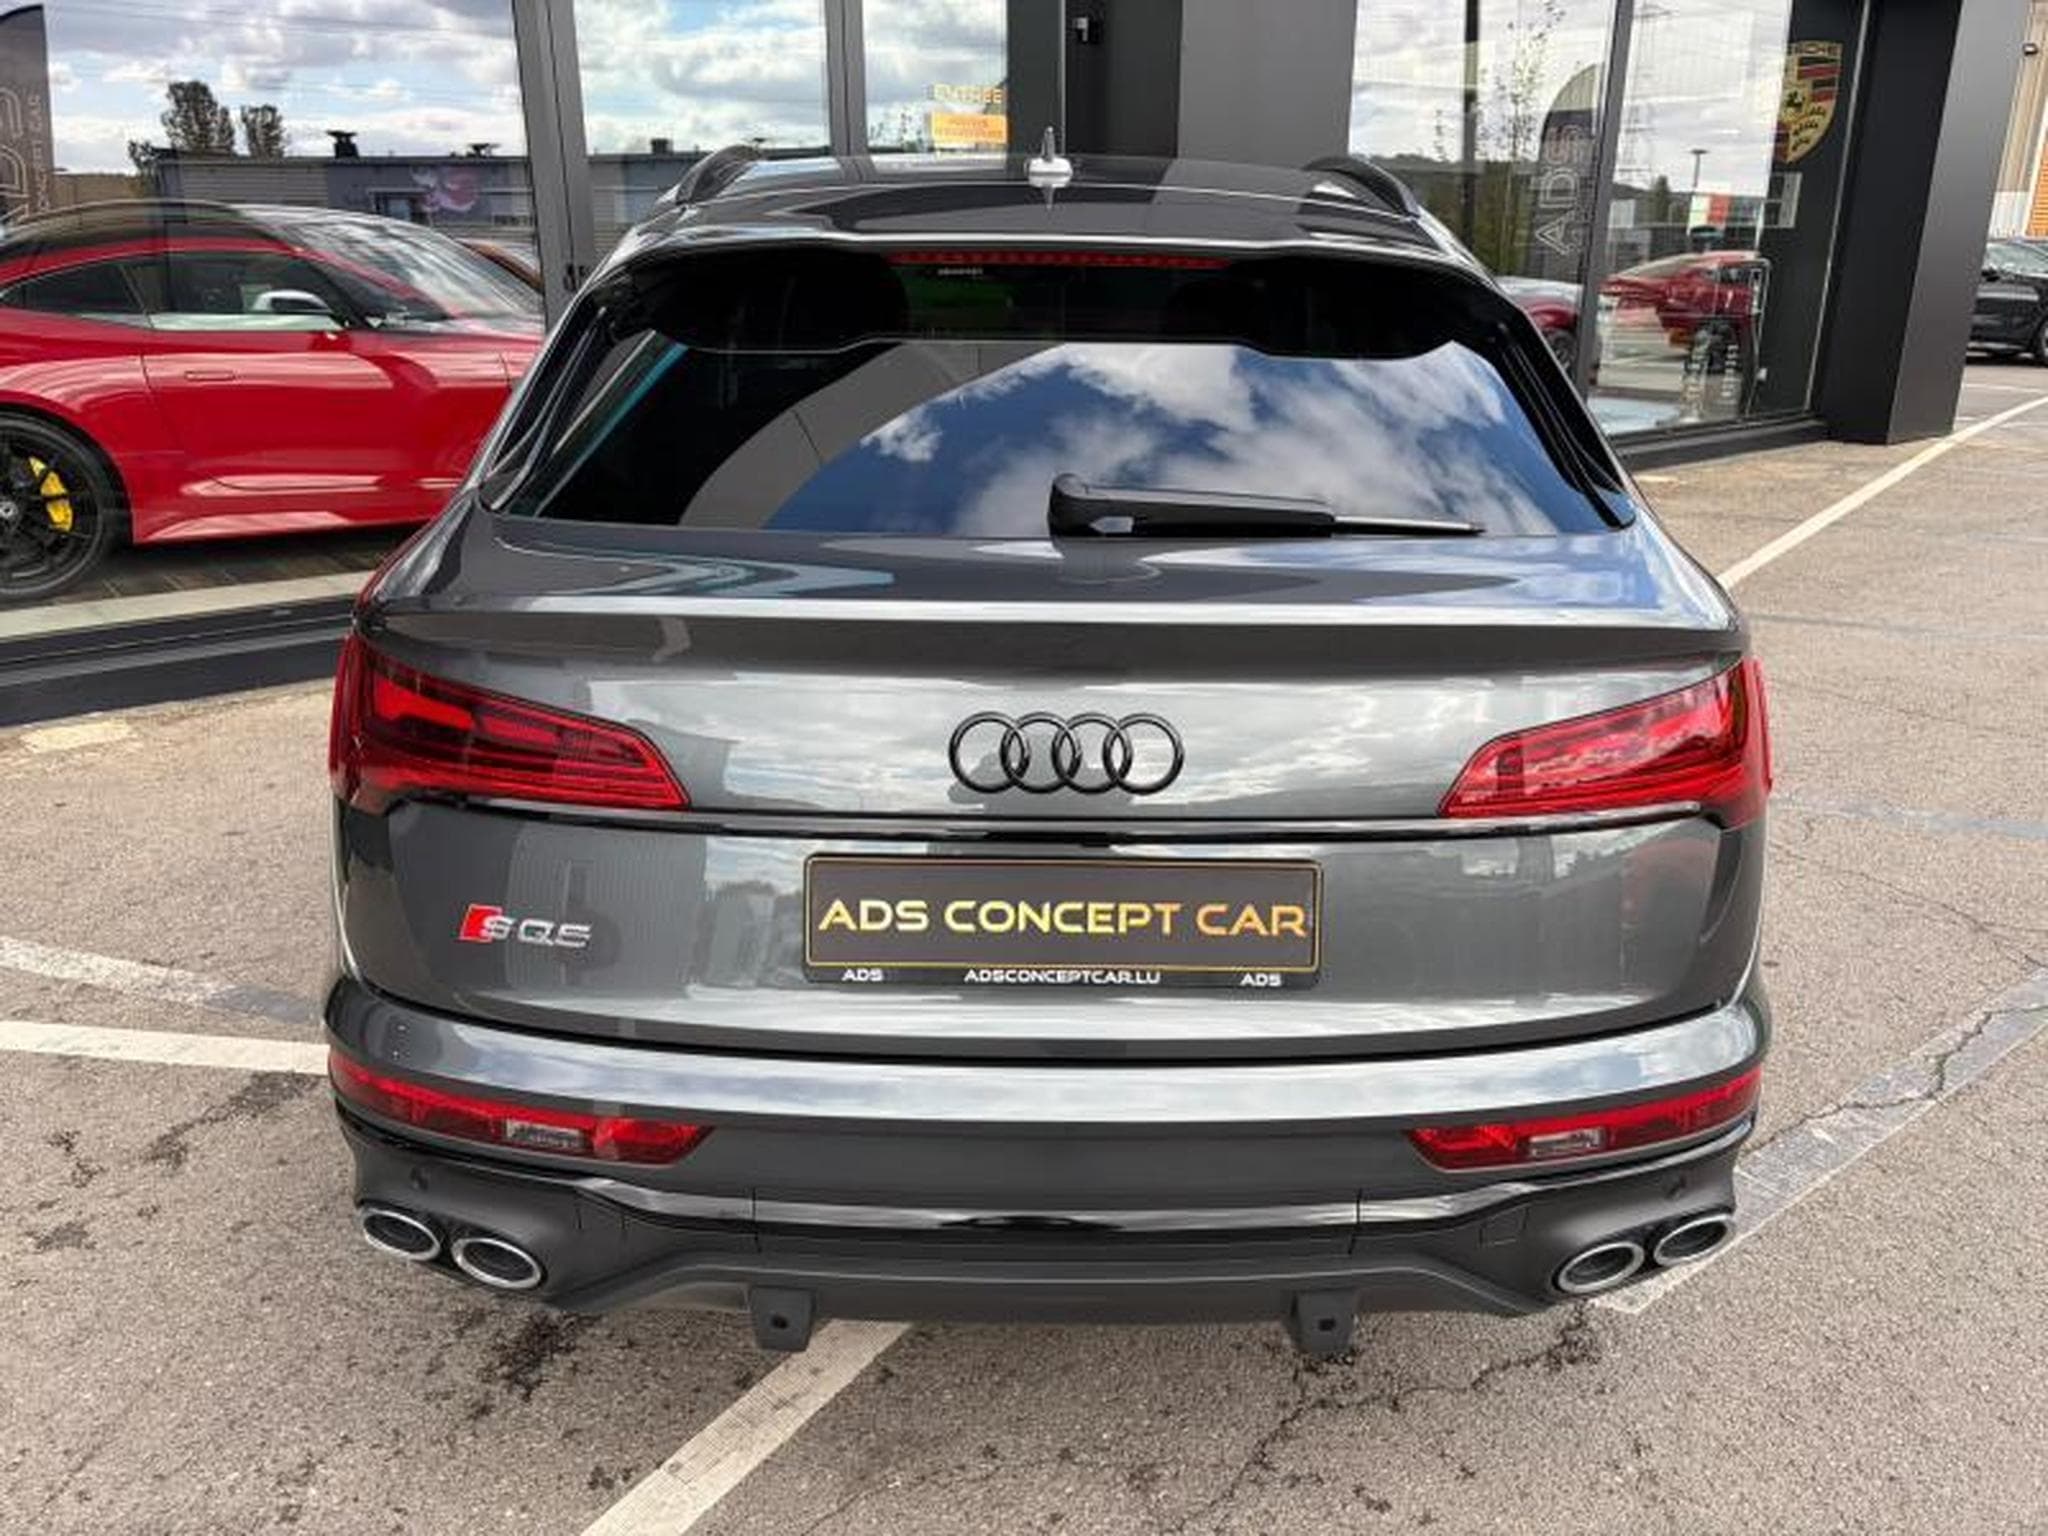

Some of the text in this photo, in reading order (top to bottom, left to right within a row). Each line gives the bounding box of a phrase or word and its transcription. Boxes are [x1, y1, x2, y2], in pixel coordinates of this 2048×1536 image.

[1535, 124, 1580, 256] ADS
[478, 913, 592, 948] SQ5
[818, 899, 1307, 937] ADS CONCEPT CAR
[841, 968, 884, 982] ADS
[964, 969, 1161, 985] ADSCONCEPTCAR.LU
[1240, 973, 1282, 987] ADS
